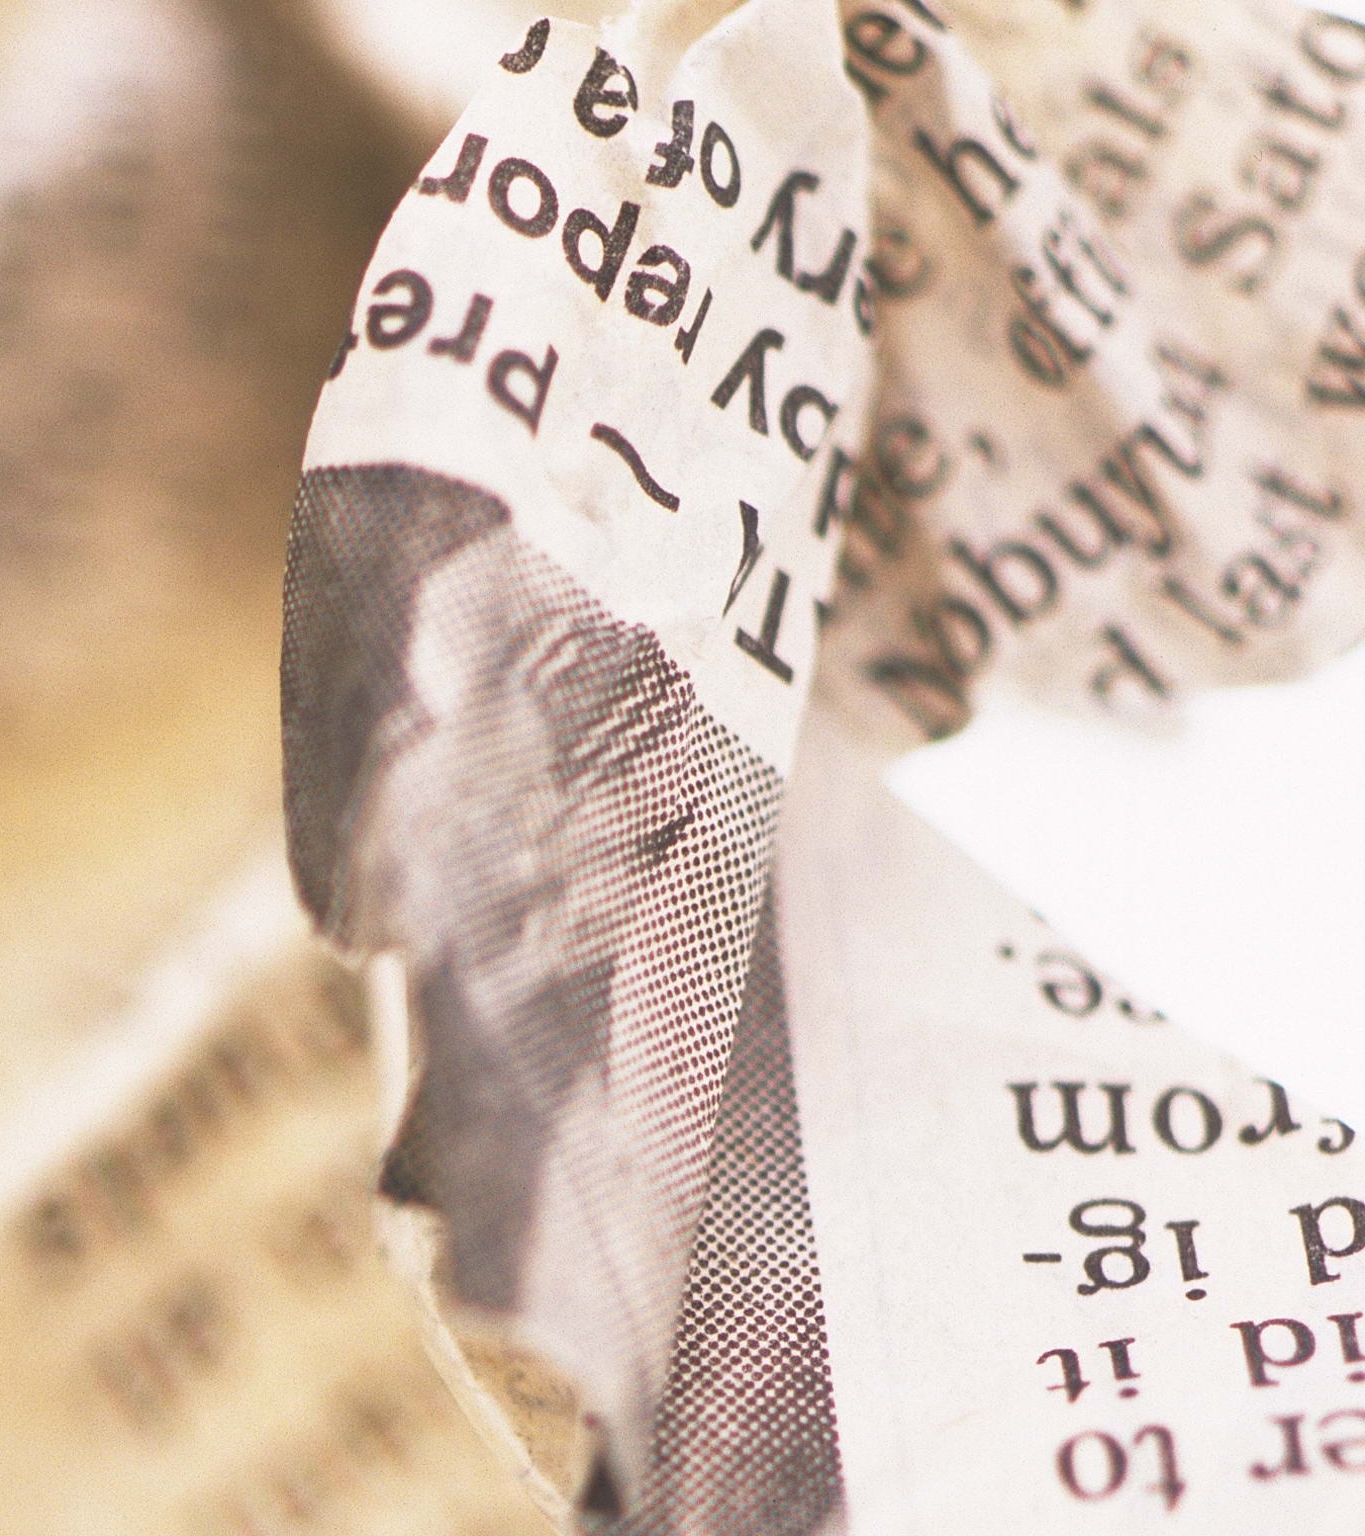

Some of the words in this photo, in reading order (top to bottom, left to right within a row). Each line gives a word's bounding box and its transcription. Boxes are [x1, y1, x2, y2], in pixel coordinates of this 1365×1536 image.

[644, 98, 743, 210] of
[1019, 1196, 1211, 1302] ig-
[1032, 1335, 1145, 1404] it
[1052, 1422, 1189, 1514] to
